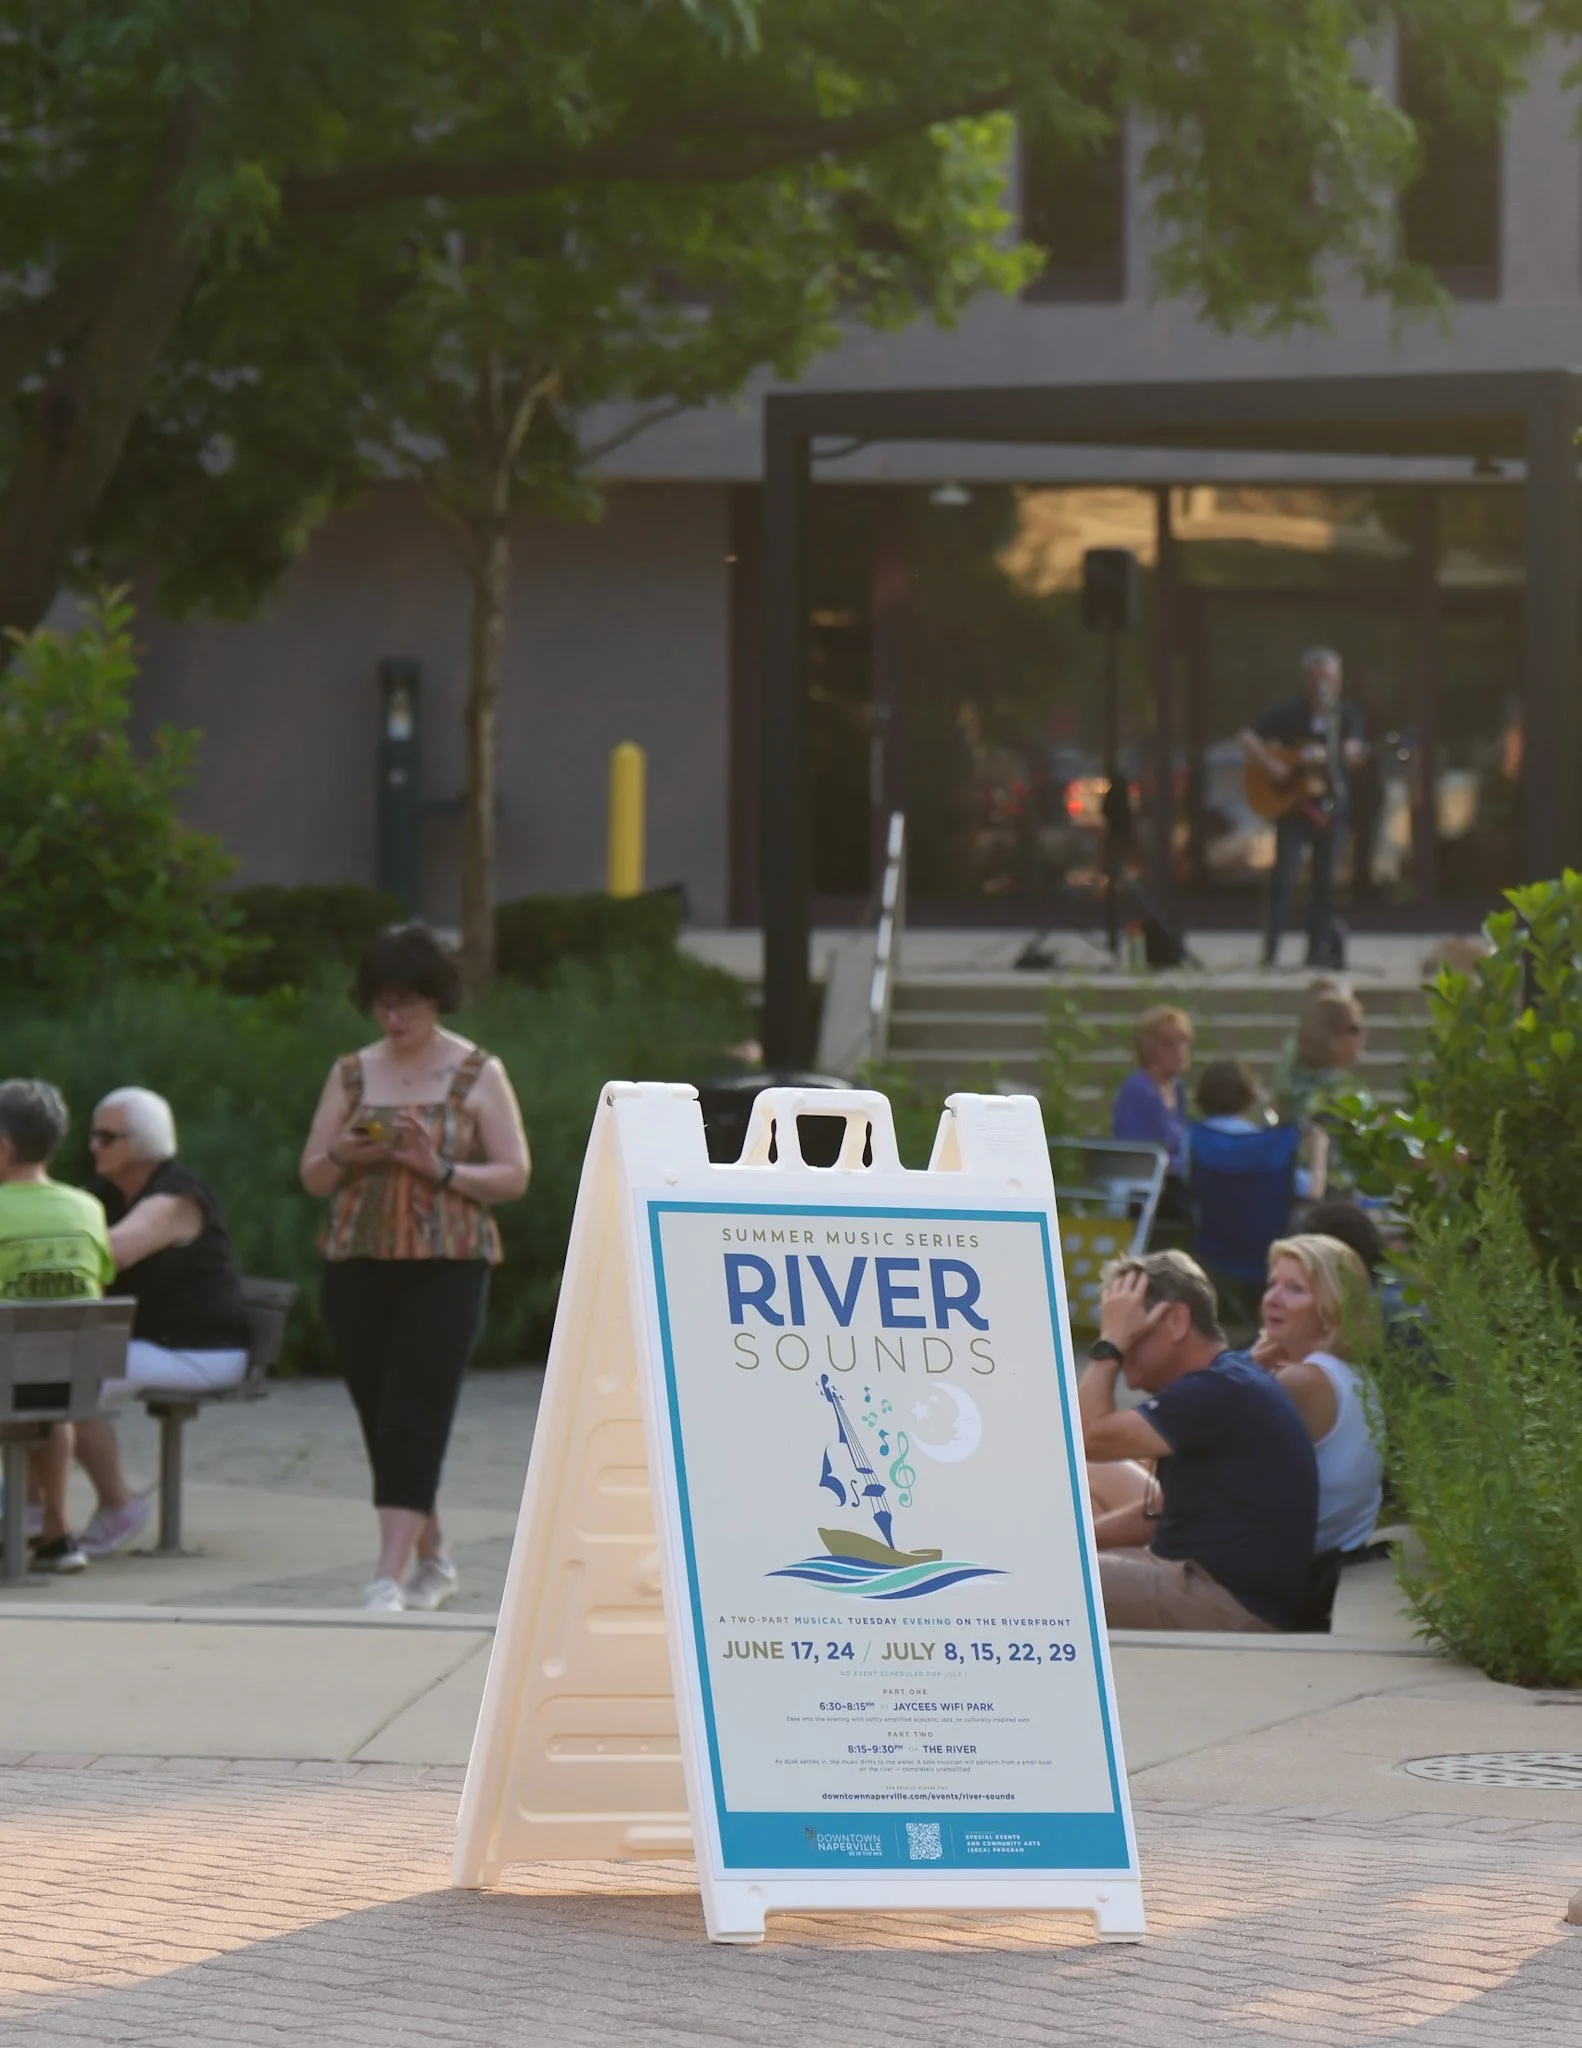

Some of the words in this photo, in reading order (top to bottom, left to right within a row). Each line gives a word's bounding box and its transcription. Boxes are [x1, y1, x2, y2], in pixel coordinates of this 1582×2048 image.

[722, 1228, 814, 1243] SUMMER
[826, 1231, 894, 1246] MUSIC
[905, 1233, 979, 1248] SERIES
[723, 1253, 990, 1331] RIVER
[733, 1332, 995, 1375] SOUNDS
[720, 1616, 726, 1624] A
[731, 1616, 789, 1624] TWO-PART
[794, 1617, 843, 1625] MUSICAL
[848, 1617, 897, 1625] TUESDAY
[902, 1618, 951, 1626] EVENING
[956, 1618, 971, 1626] ON
[977, 1618, 996, 1626] THE
[1002, 1618, 1071, 1626] RIVERFRONT
[723, 1640, 784, 1660] JUNE
[791, 1641, 820, 1664] 17,
[826, 1641, 855, 1660] 24
[881, 1642, 936, 1661] JULY
[944, 1642, 965, 1665] 8,
[971, 1642, 1001, 1665] 15,
[1008, 1643, 1042, 1665] 22,
[1049, 1643, 1076, 1662] 29
[882, 1688, 904, 1696] PART
[910, 1688, 928, 1696] ONE
[893, 1702, 938, 1712] JAYCEES
[940, 1702, 964, 1712] WIFI
[967, 1702, 994, 1712] PARK
[827, 1716, 850, 1724] evening
[922, 1745, 943, 1754] THE
[946, 1745, 977, 1754] RIVER
[822, 1792, 1015, 1801] downtownnaperville.com/events/river-sounds
[816, 1833, 881, 1843] DOWNTOWN
[818, 1842, 882, 1852] NAPERVILLE
